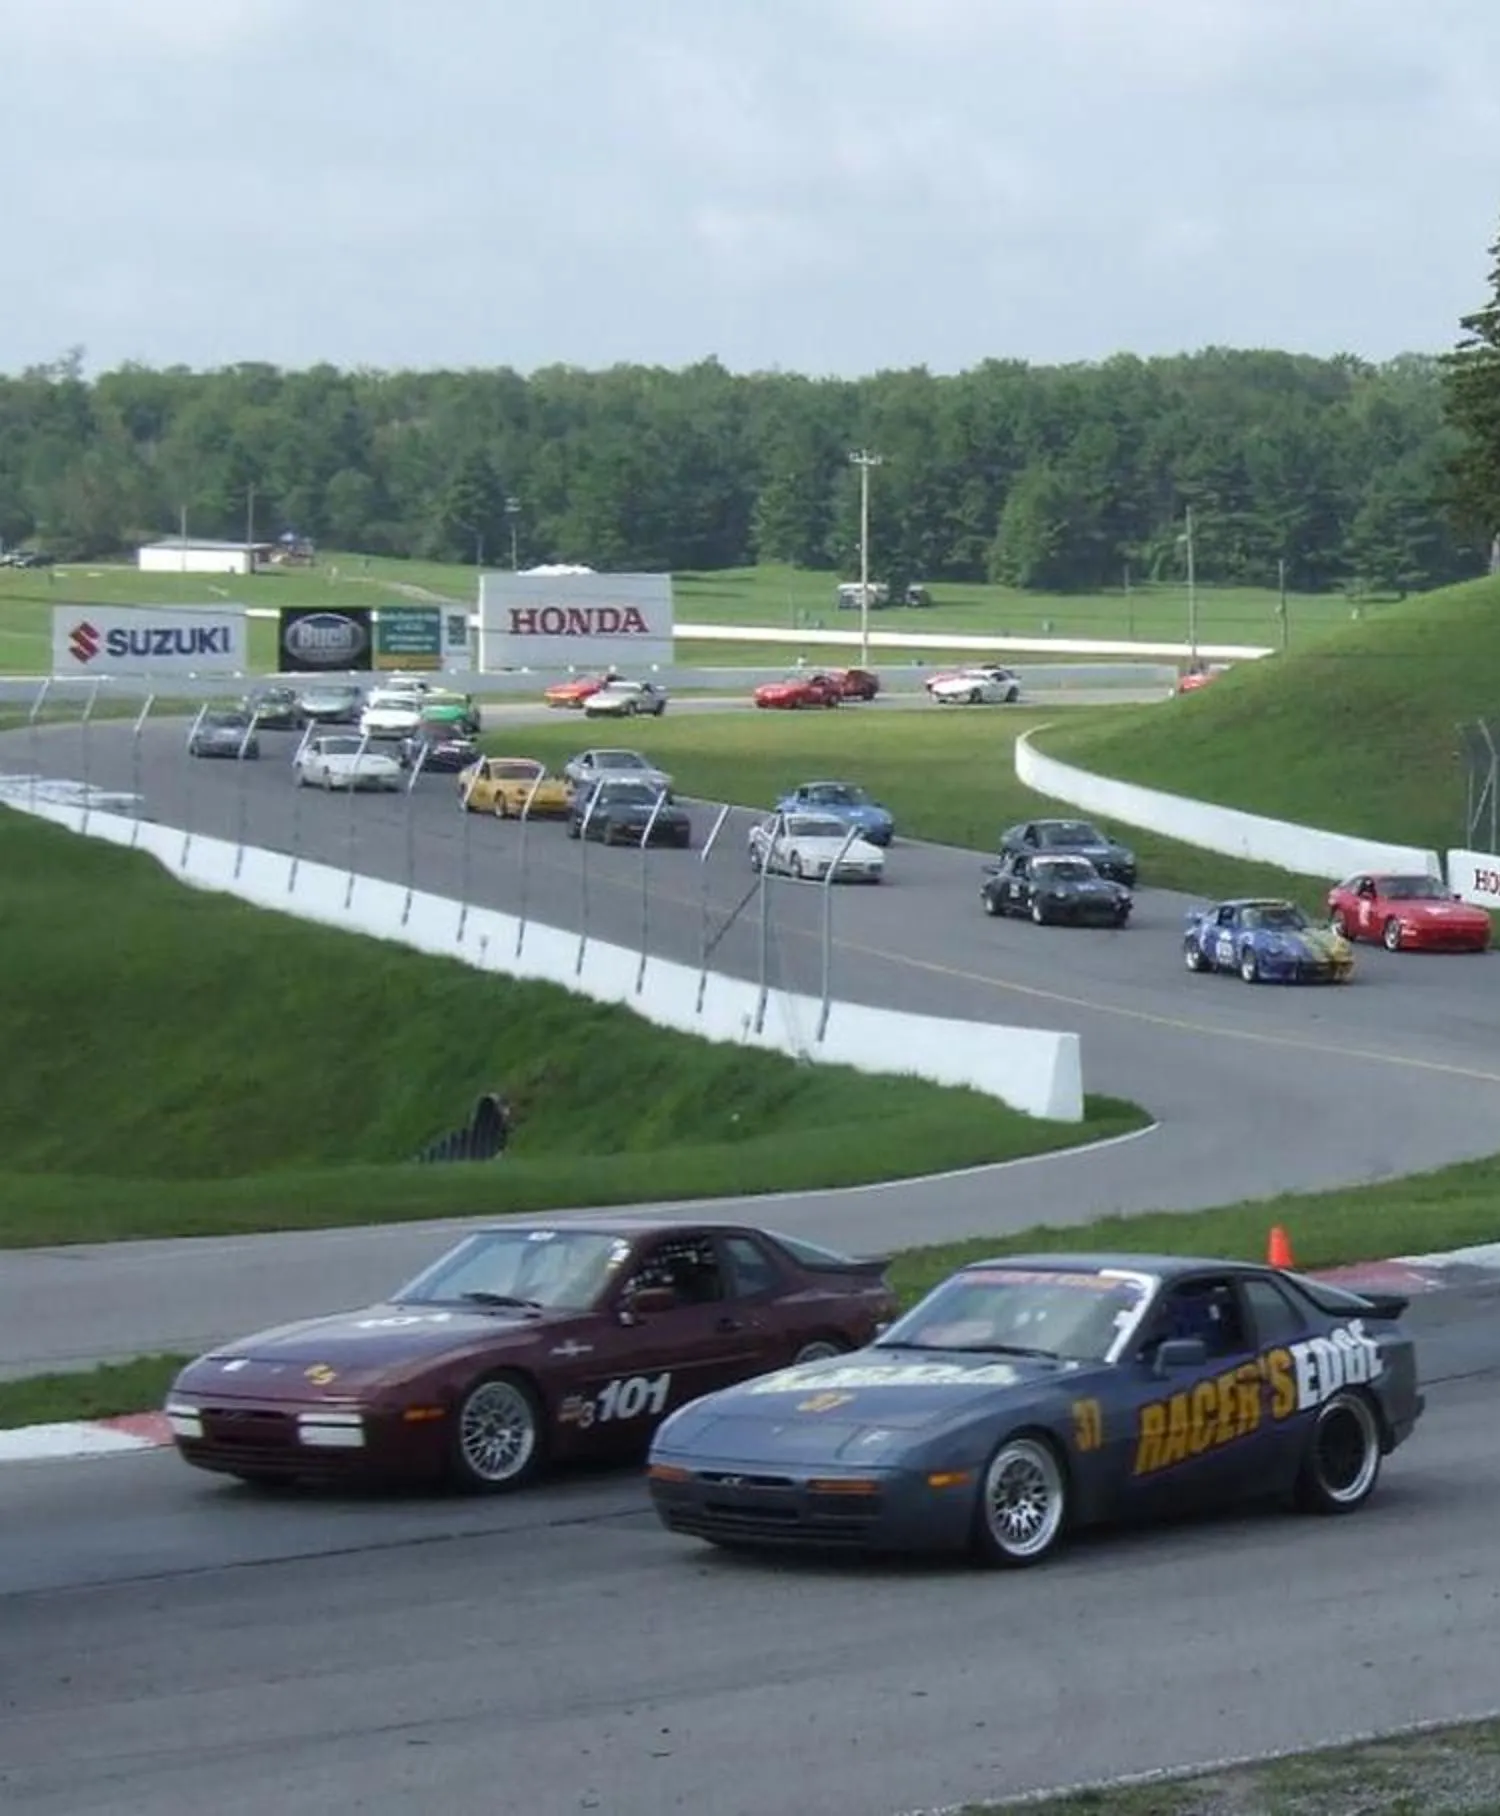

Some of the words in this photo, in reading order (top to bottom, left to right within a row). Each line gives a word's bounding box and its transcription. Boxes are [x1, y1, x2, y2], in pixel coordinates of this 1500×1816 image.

[509, 606, 649, 635] HONDA
[106, 626, 230, 657] SUZUKI
[597, 1372, 671, 1422] 101
[1135, 1346, 1297, 1475] RACER'S
[1291, 1318, 1384, 1411] EDGE
